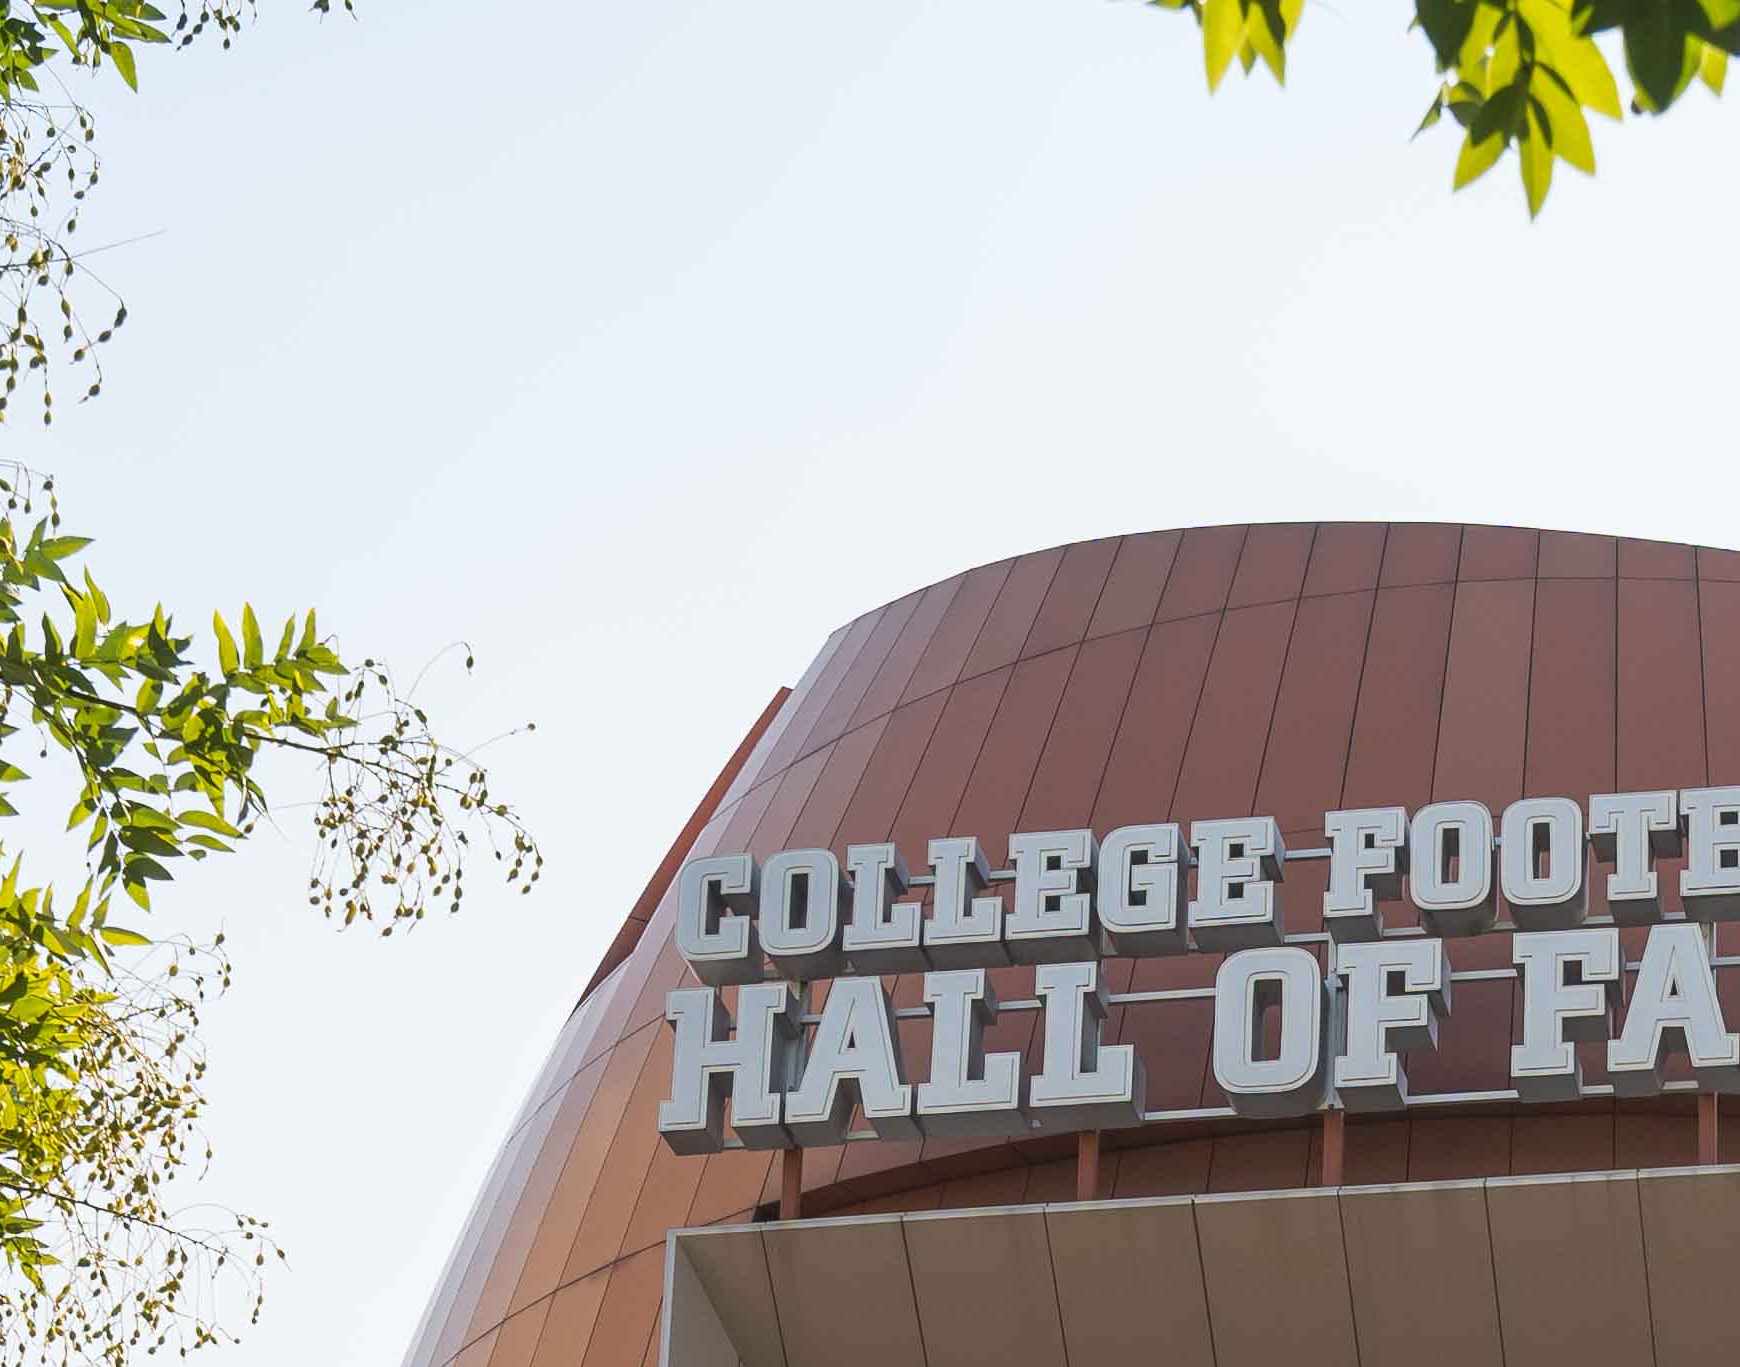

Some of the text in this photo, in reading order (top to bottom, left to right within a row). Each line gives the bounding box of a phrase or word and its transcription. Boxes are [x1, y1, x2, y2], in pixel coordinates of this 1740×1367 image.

[674, 816, 1280, 975] COLLEGE
[660, 960, 1140, 1148] HALL
[1212, 938, 1448, 1108] OF
